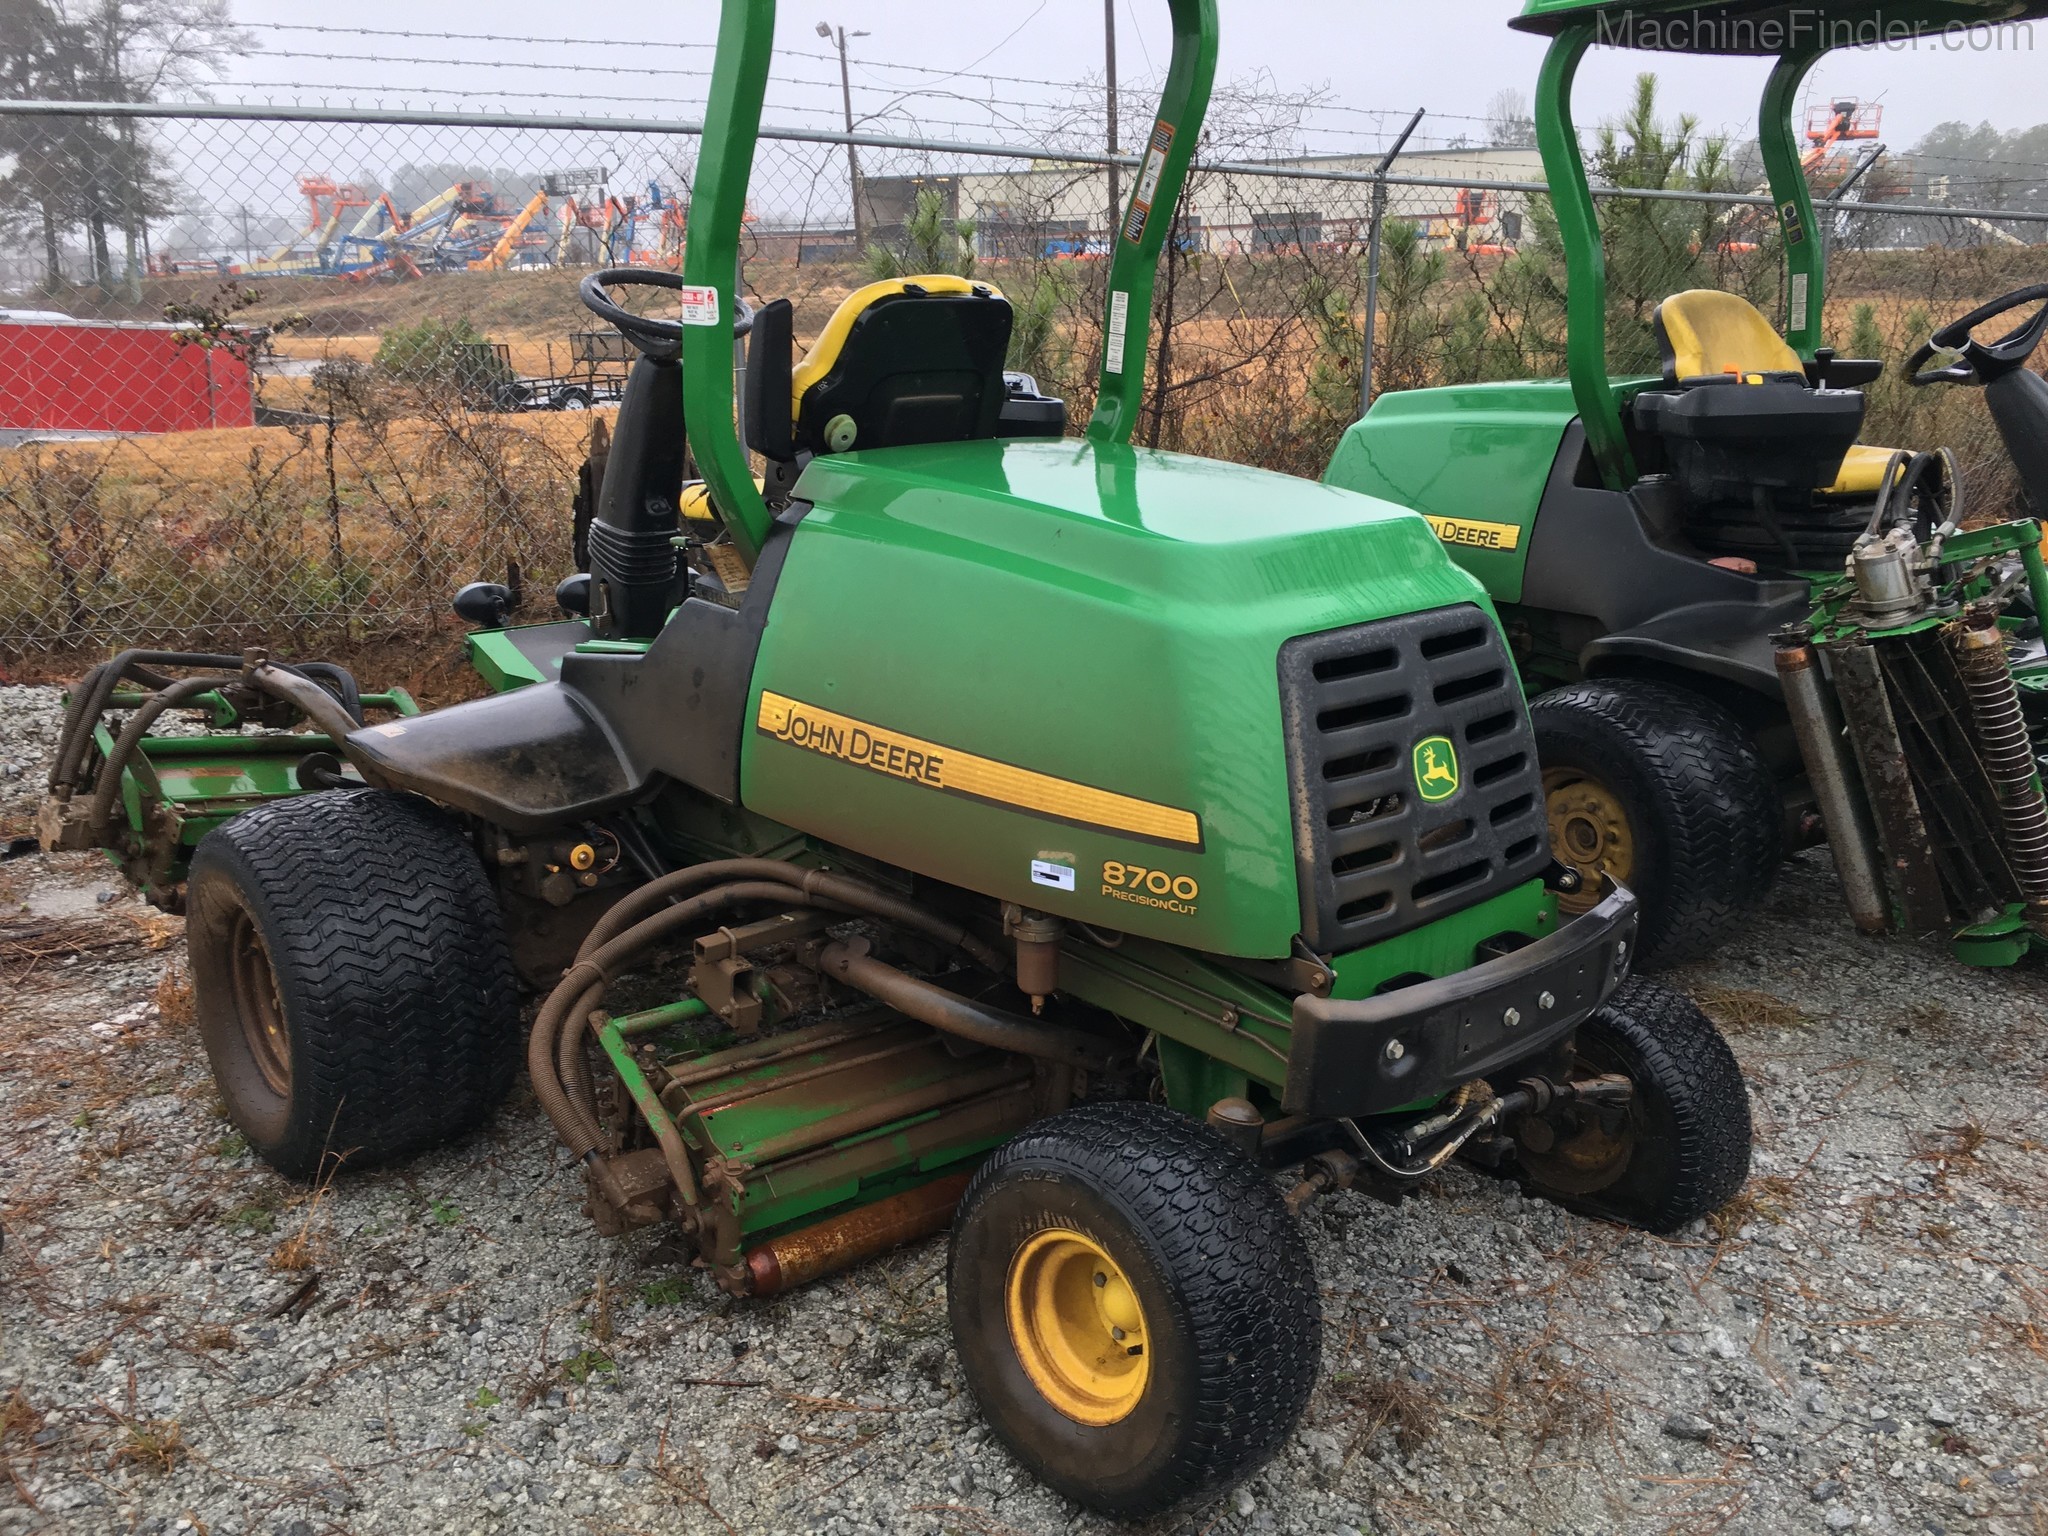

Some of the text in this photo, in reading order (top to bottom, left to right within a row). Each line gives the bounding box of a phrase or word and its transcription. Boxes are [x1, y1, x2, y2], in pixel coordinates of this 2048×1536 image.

[1443, 521, 1501, 546] DEERE
[776, 708, 944, 784] JOHN DEERE
[1102, 860, 1199, 901] 8700
